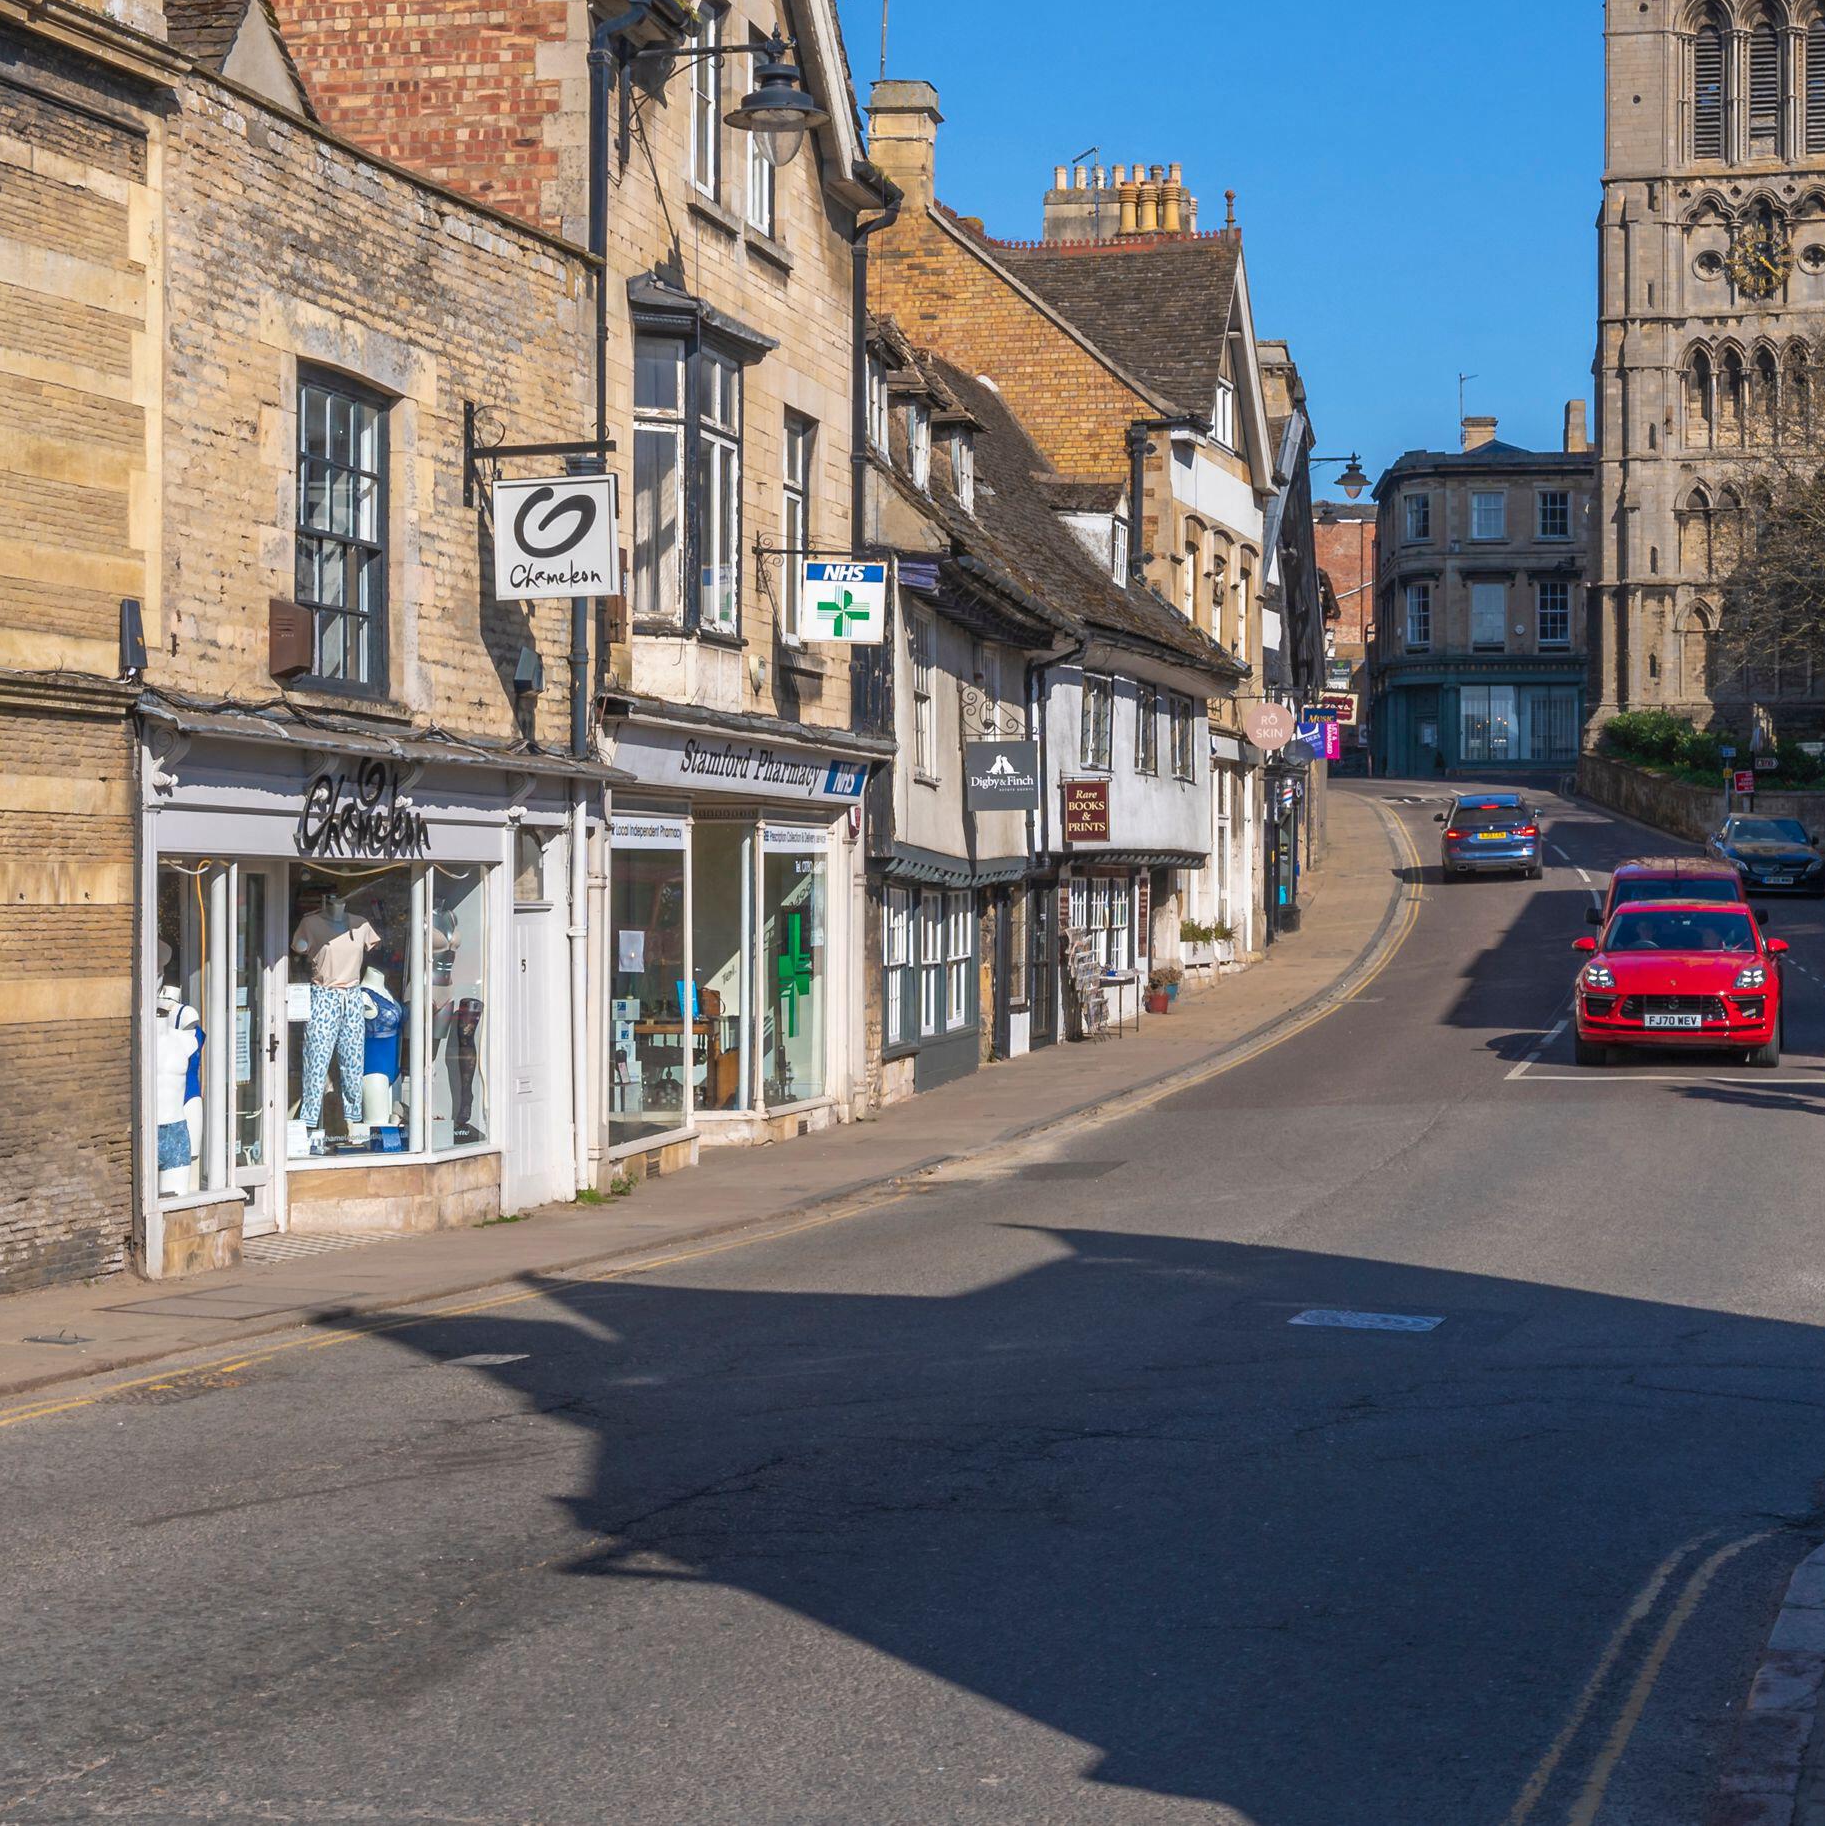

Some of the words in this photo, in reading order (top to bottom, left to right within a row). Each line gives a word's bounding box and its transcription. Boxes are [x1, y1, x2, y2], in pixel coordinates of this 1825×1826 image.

[510, 559, 603, 589] Chameleon
[823, 564, 866, 582] NHS
[1255, 728, 1283, 739] SKIN
[680, 737, 753, 780] Stamford
[753, 749, 824, 797] Pharmacy
[831, 763, 864, 794] NHS
[971, 776, 1000, 790] Digby
[1006, 774, 1034, 786] Finch
[1076, 789, 1098, 800] Rare
[1068, 801, 1105, 811] BOOKS
[302, 773, 432, 857] Chameleon
[1081, 811, 1091, 821] &
[616, 822, 629, 836] Local
[630, 823, 660, 838] Independent
[660, 825, 682, 842] Pharmacy
[1068, 822, 1106, 832] PRINTS
[521, 958, 528, 973] 5
[1649, 1015, 1676, 1026] FJ70
